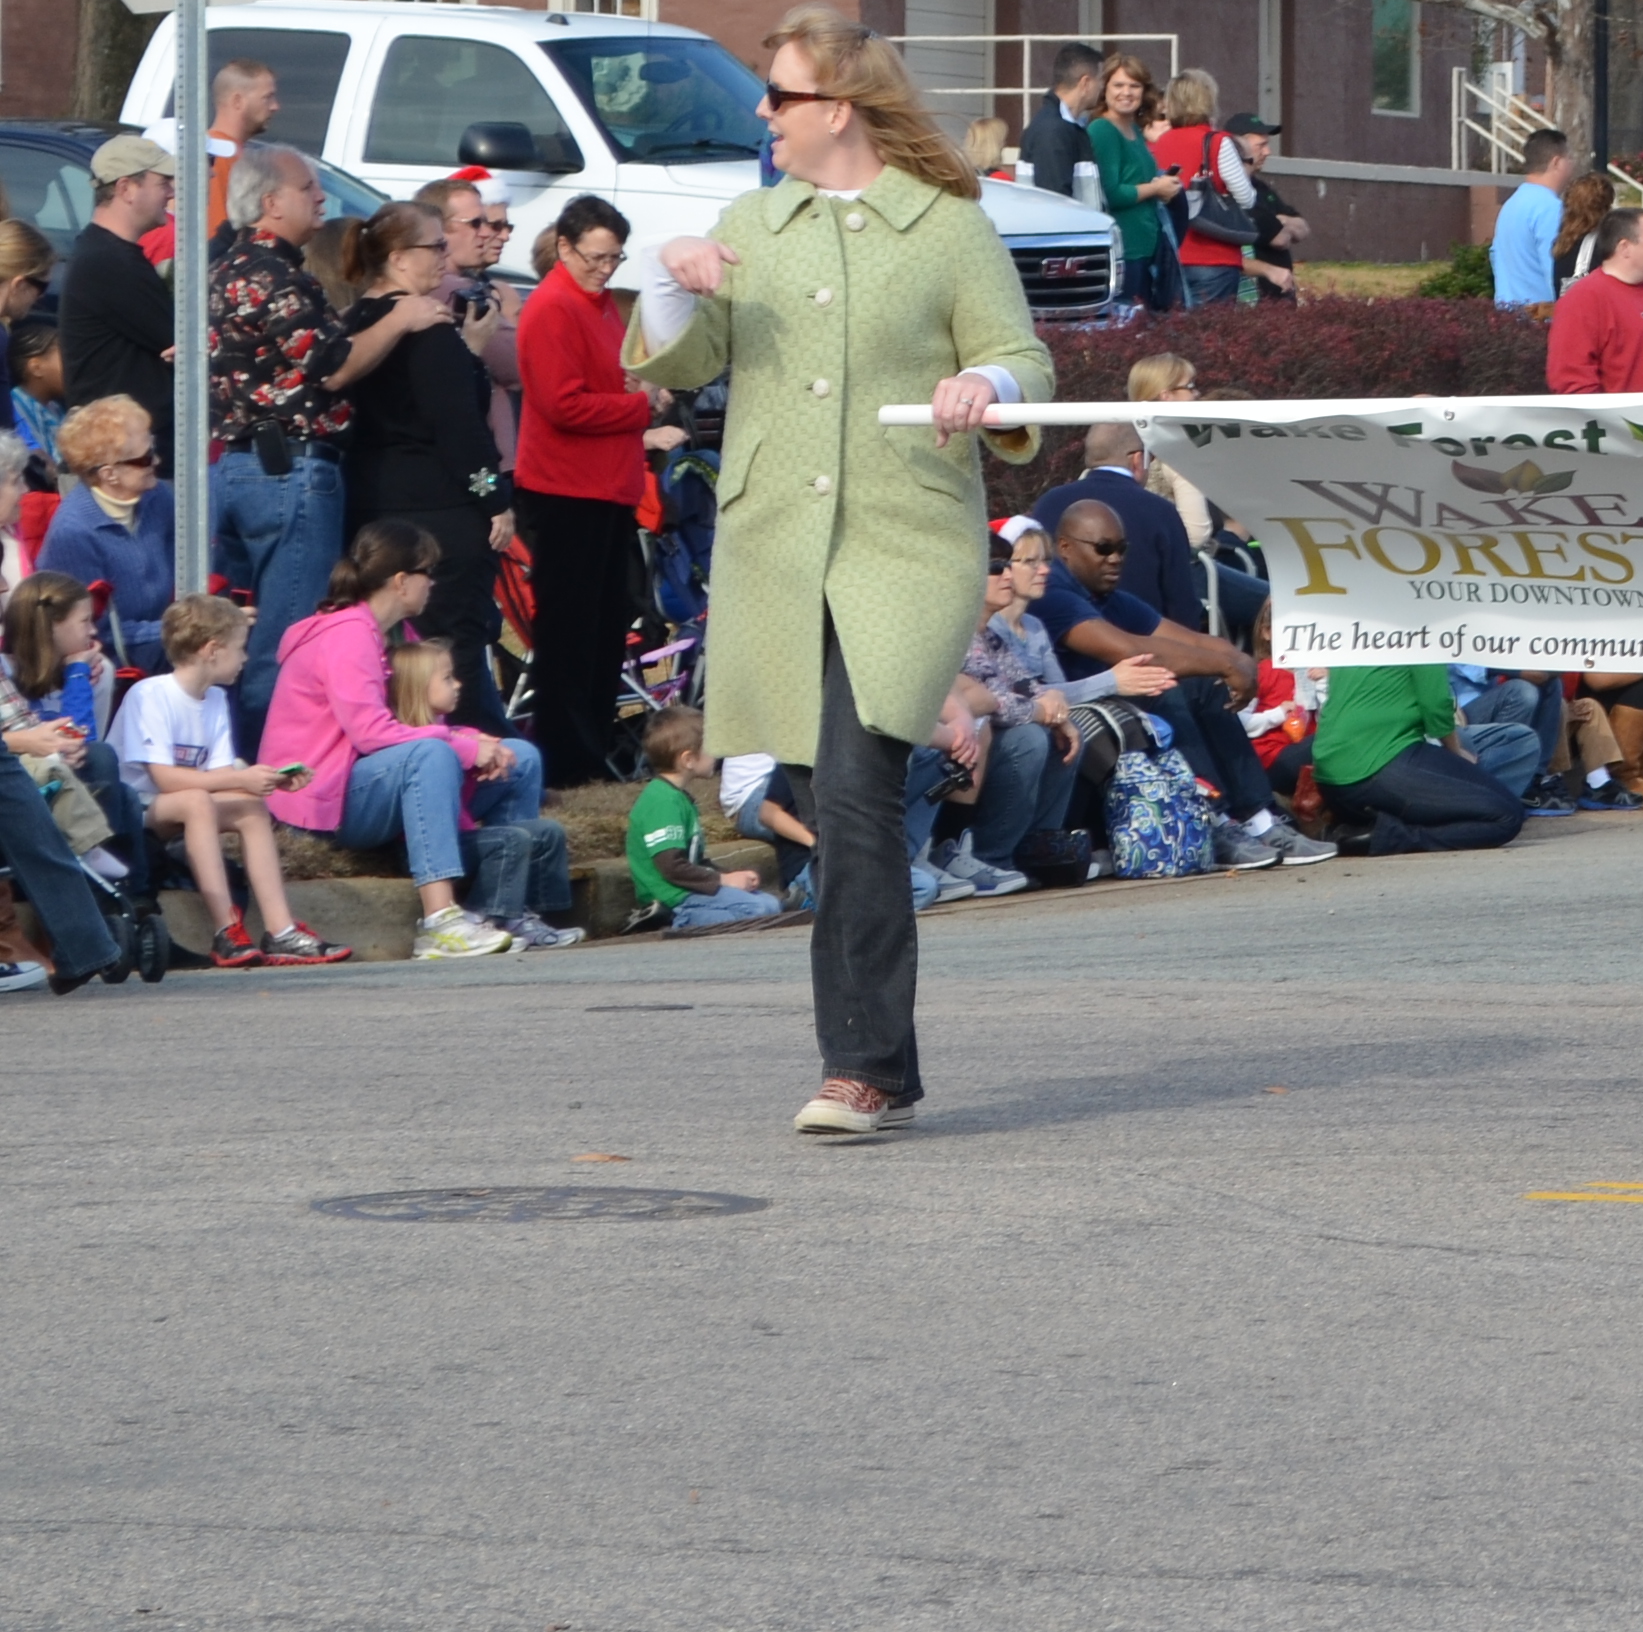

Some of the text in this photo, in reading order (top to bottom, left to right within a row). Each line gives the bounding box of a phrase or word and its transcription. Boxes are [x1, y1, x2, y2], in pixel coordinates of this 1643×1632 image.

[1387, 419, 1608, 457] Forest
[1408, 580, 1484, 603] YOUR
[1283, 623, 1342, 652] The
[1351, 621, 1431, 651] heart
[1438, 624, 1469, 658] of
[1472, 633, 1521, 655] our
